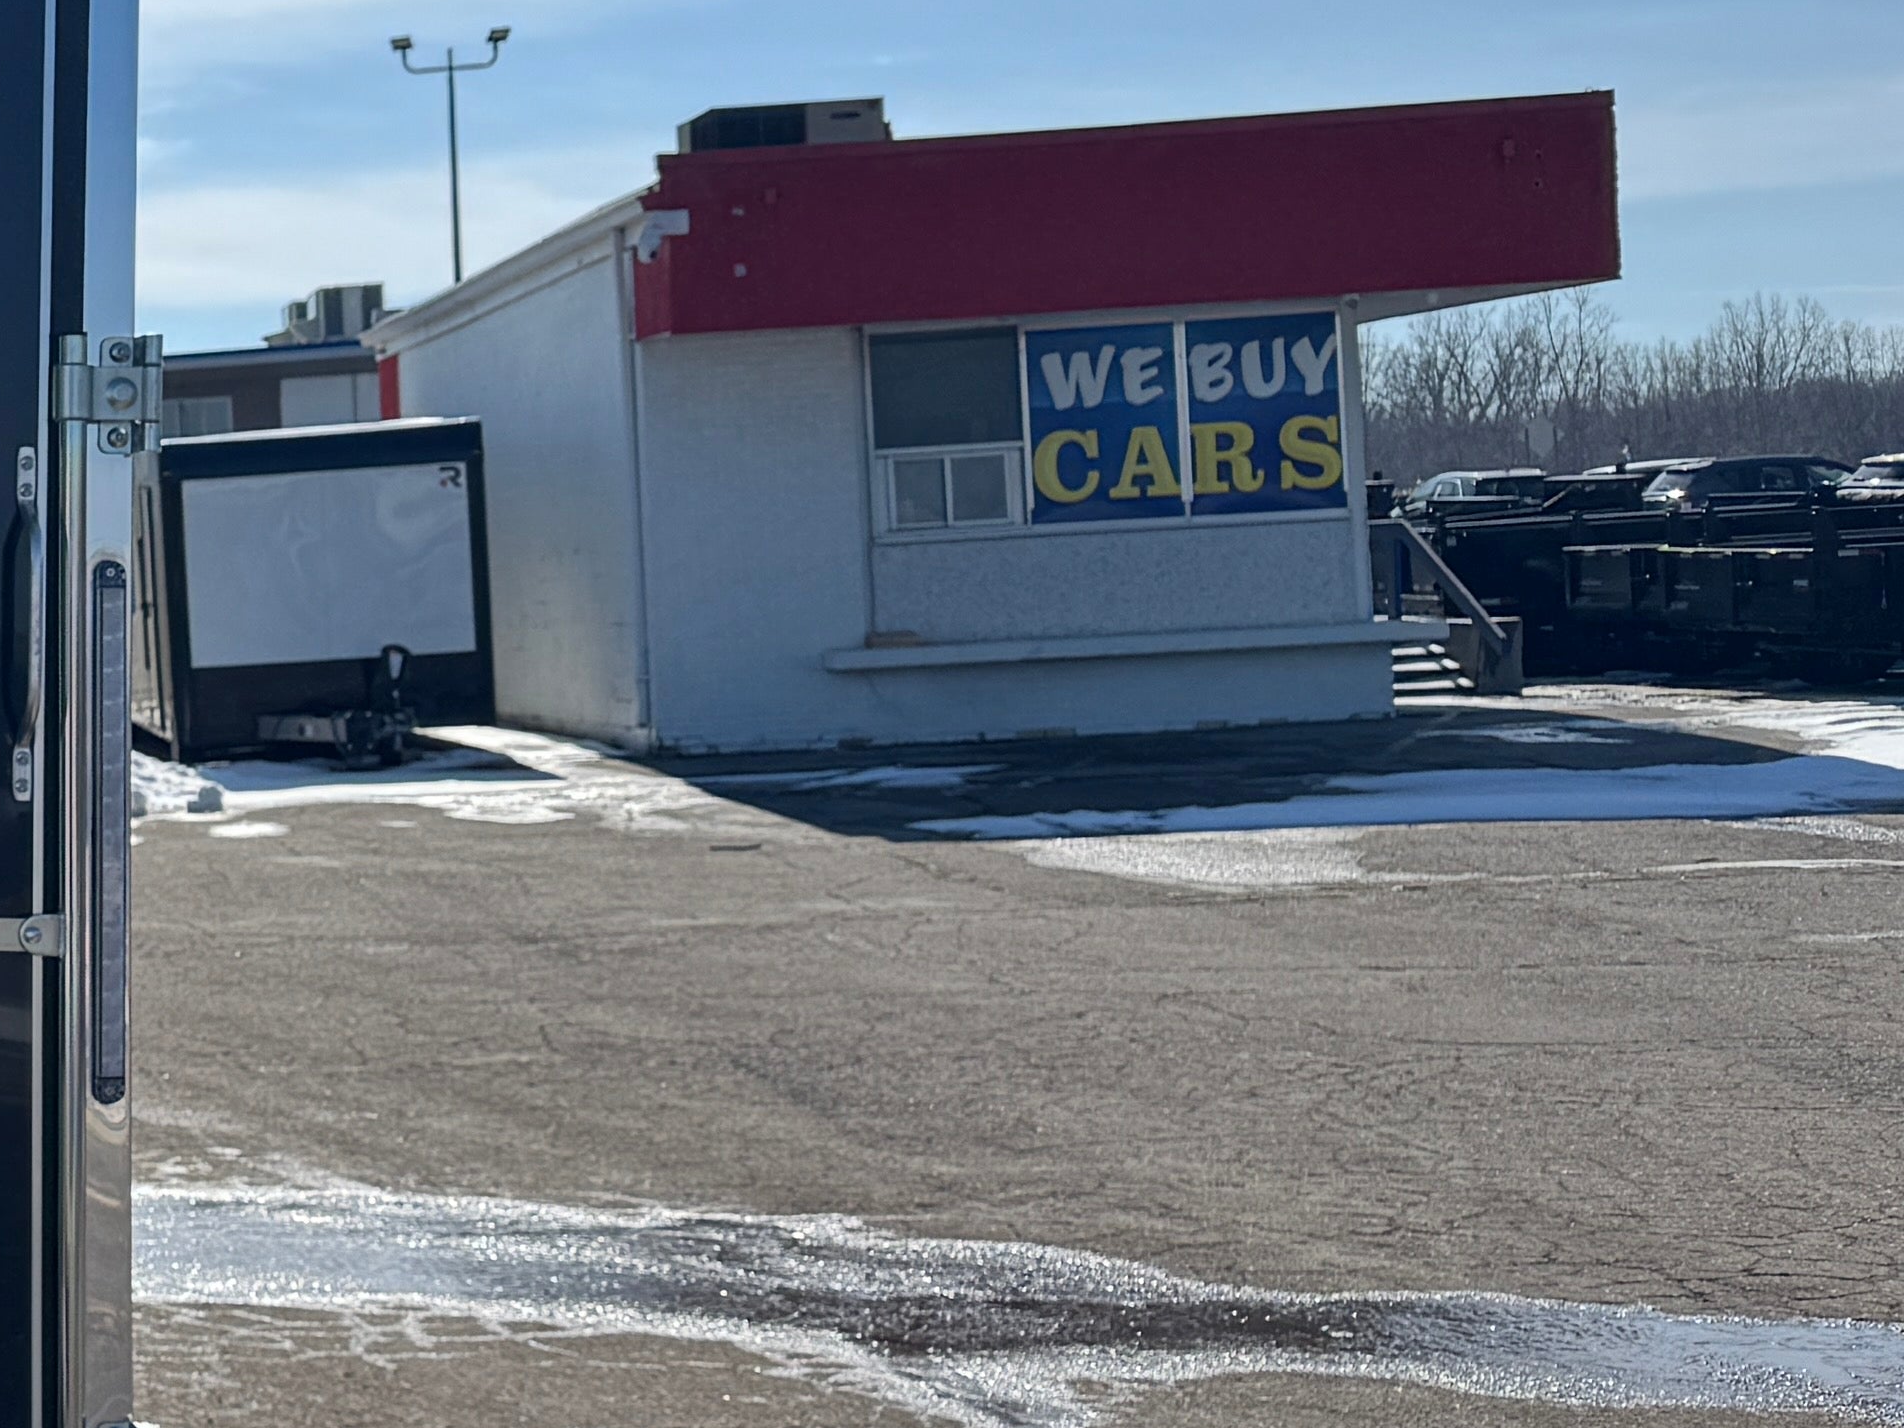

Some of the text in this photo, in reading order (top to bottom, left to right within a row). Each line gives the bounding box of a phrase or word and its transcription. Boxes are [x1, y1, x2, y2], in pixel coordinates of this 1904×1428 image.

[1040, 333, 1337, 411] WE BUY
[1033, 415, 1344, 504] CARS
